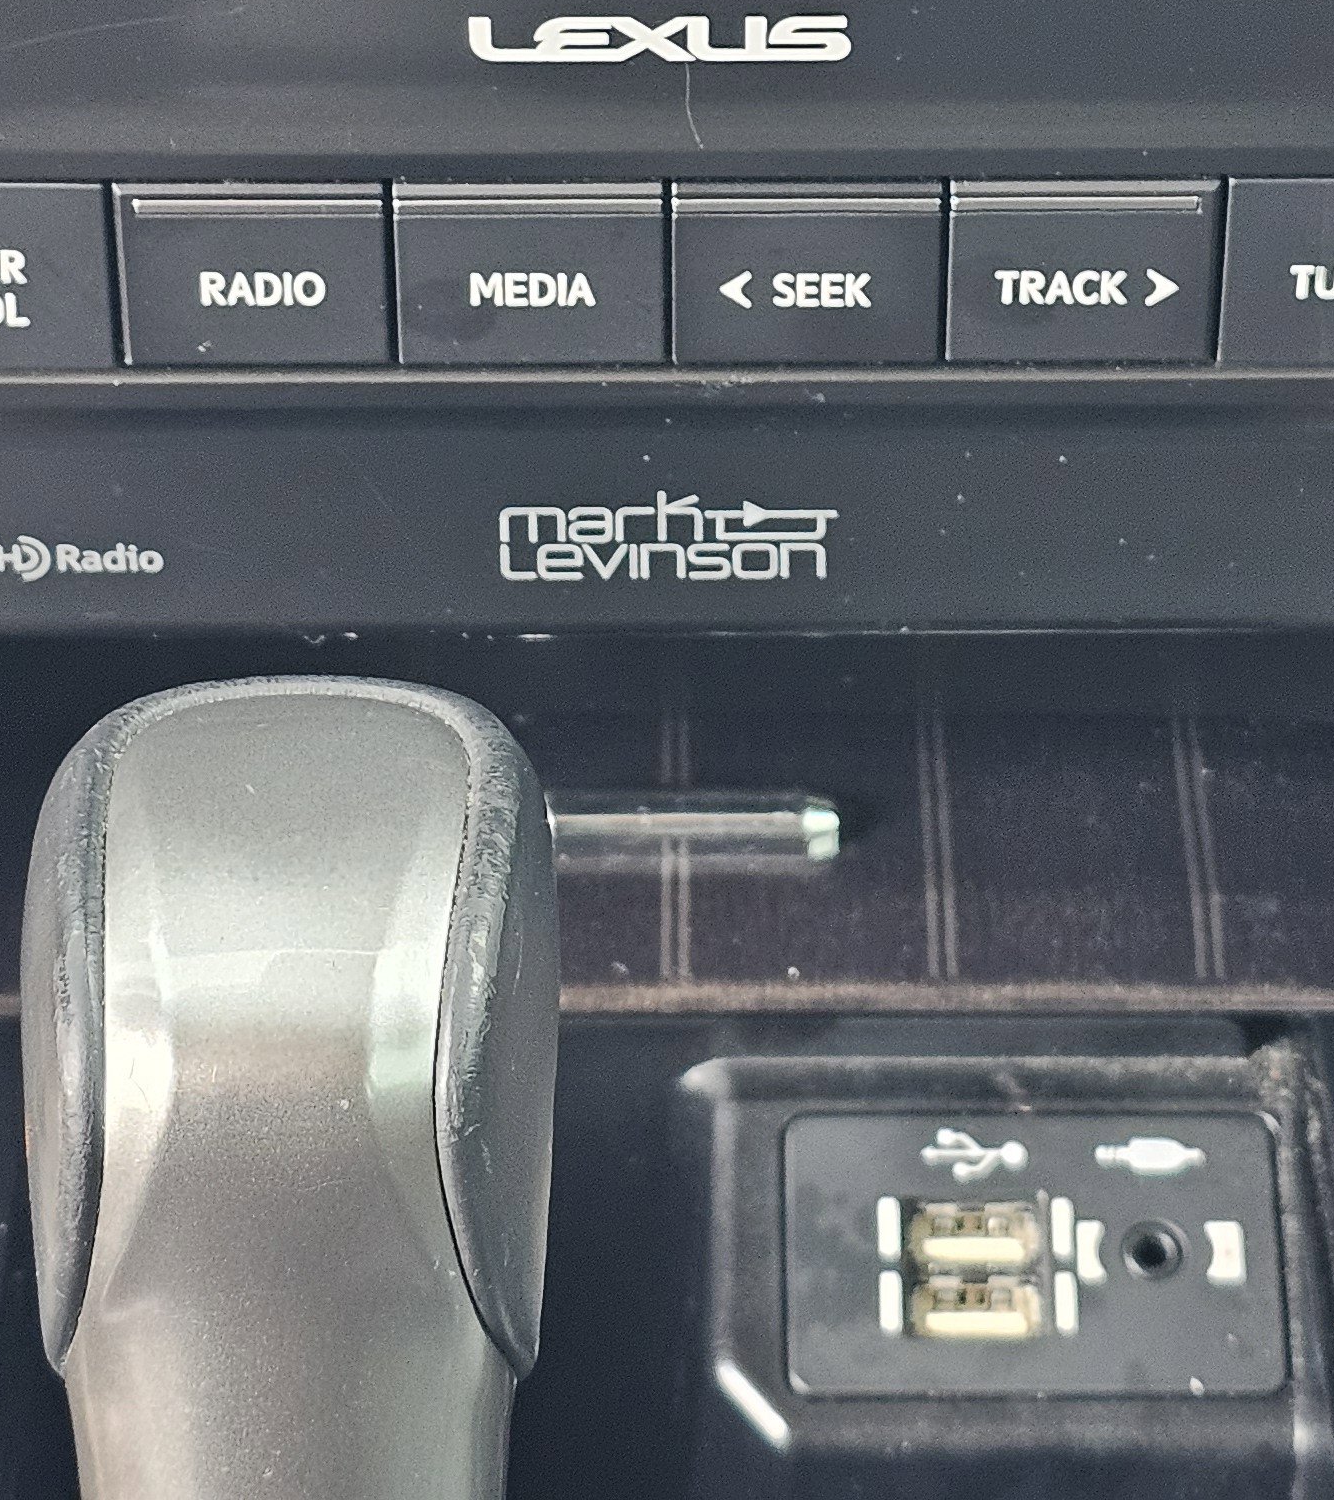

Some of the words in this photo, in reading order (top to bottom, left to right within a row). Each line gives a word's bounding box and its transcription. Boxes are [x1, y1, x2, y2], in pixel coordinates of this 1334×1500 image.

[467, 15, 852, 63] LEXUS
[199, 271, 326, 307] RADIO
[469, 272, 597, 307] MEDIA
[772, 272, 872, 308] SEEK
[994, 269, 1128, 306] TRACK
[55, 542, 164, 574] Radio
[499, 542, 827, 581] Levinson
